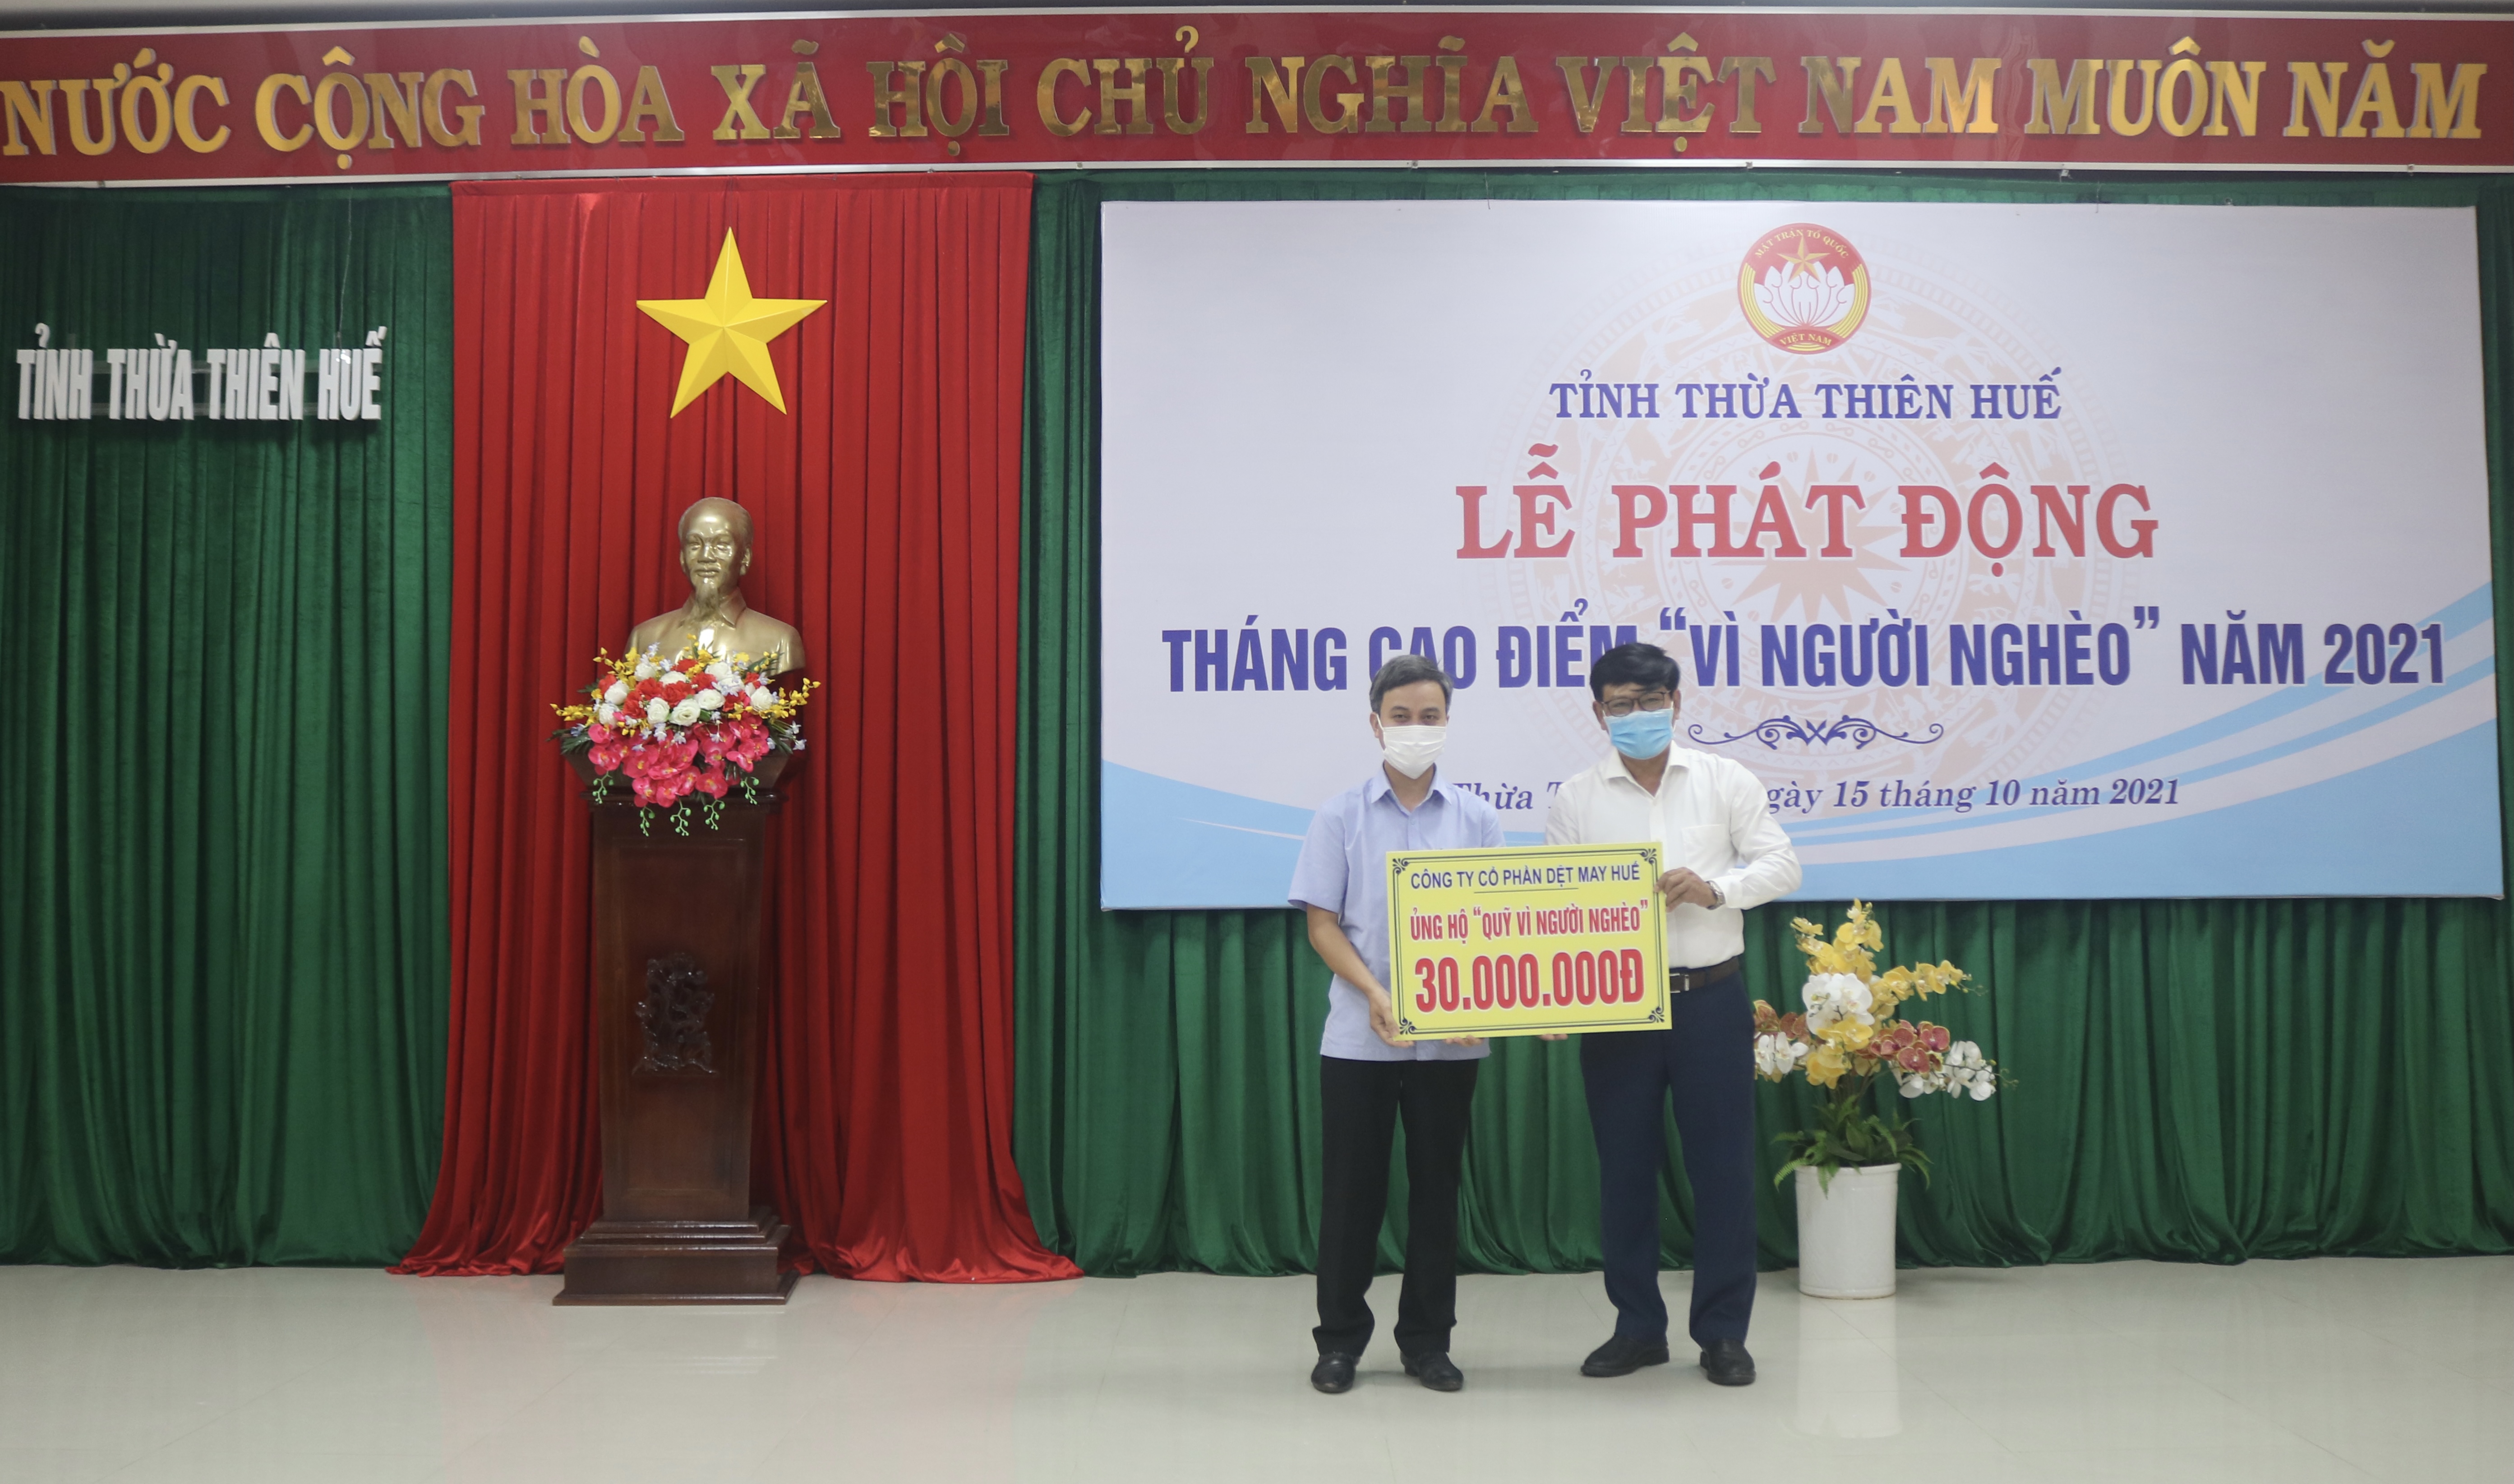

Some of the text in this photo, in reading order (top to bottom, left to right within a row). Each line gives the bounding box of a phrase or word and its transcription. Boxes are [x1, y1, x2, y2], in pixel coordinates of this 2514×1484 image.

[2, 25, 2489, 170] NƯỚC CỘNG HÒA XÃ HỘI CHỦ NGHĨA VIỆT NAM MUÔN NĂM
[1755, 238, 1774, 258] MẶT
[1807, 229, 1822, 239] TỔ
[1823, 235, 1849, 258] QUỐC
[1779, 333, 1832, 346] VIỆT NAM
[16, 323, 388, 420] TỈNH THỪA THIÊN HUẾ
[1549, 366, 2062, 419] TỈNH THỪA THIÊN HUẾ
[1455, 442, 2159, 578] LỄ PHÁT ĐỘNG
[1162, 615, 1348, 691] THÁNG
[1660, 607, 1739, 687] “VÌ
[1762, 609, 1929, 687] NGƯỜI
[1950, 606, 2160, 687] NGHÈO”
[2181, 610, 2304, 686] NĂM
[2323, 623, 2445, 686] 2021
[1452, 783, 1533, 810] hừa
[1768, 781, 1823, 814] gày
[1833, 780, 1871, 807] 15
[1879, 780, 1977, 813] tháng
[1986, 779, 2021, 806] 10
[2030, 779, 2100, 805] năm
[2109, 778, 2178, 805] 2021
[1411, 861, 1641, 889] CÔNG TY CỔ PHẦN DỆT MAY HUẾ
[1410, 899, 1649, 944] ỦNG HỘ “QUỸ VÌ NGƯỜI NGHÈO”
[1415, 949, 1644, 1013] 30.000.000Đ
